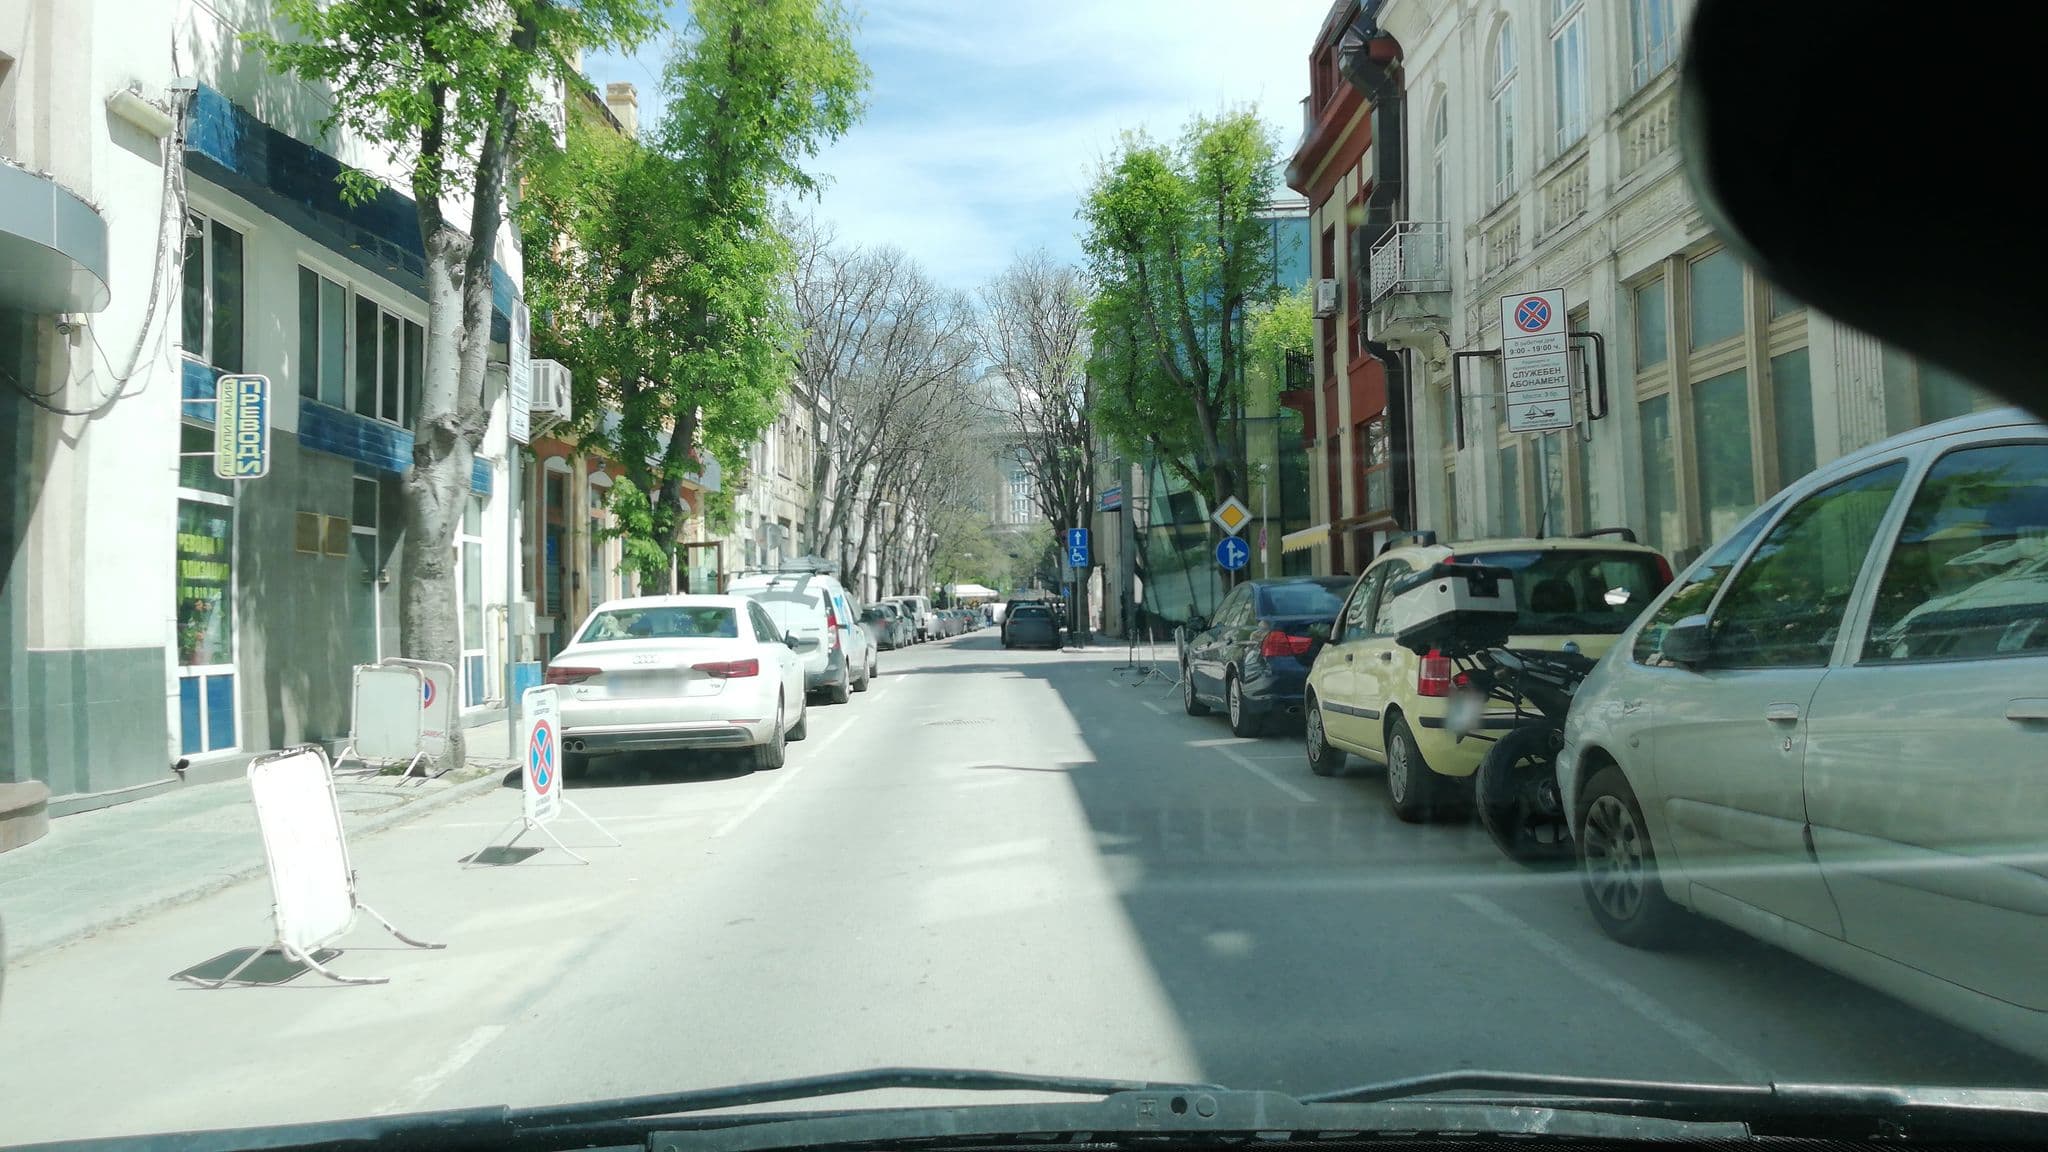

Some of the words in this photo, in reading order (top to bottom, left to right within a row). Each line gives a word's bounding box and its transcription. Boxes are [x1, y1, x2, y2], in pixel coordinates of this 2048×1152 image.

[1510, 375, 1565, 388] АБОНАМЕНТ
[1512, 367, 1561, 379] СЛУЖЕБЕН
[222, 380, 234, 473] ЛЕГАЛИЗАЦИЯ
[238, 380, 261, 474] ПРЕВОДИ
